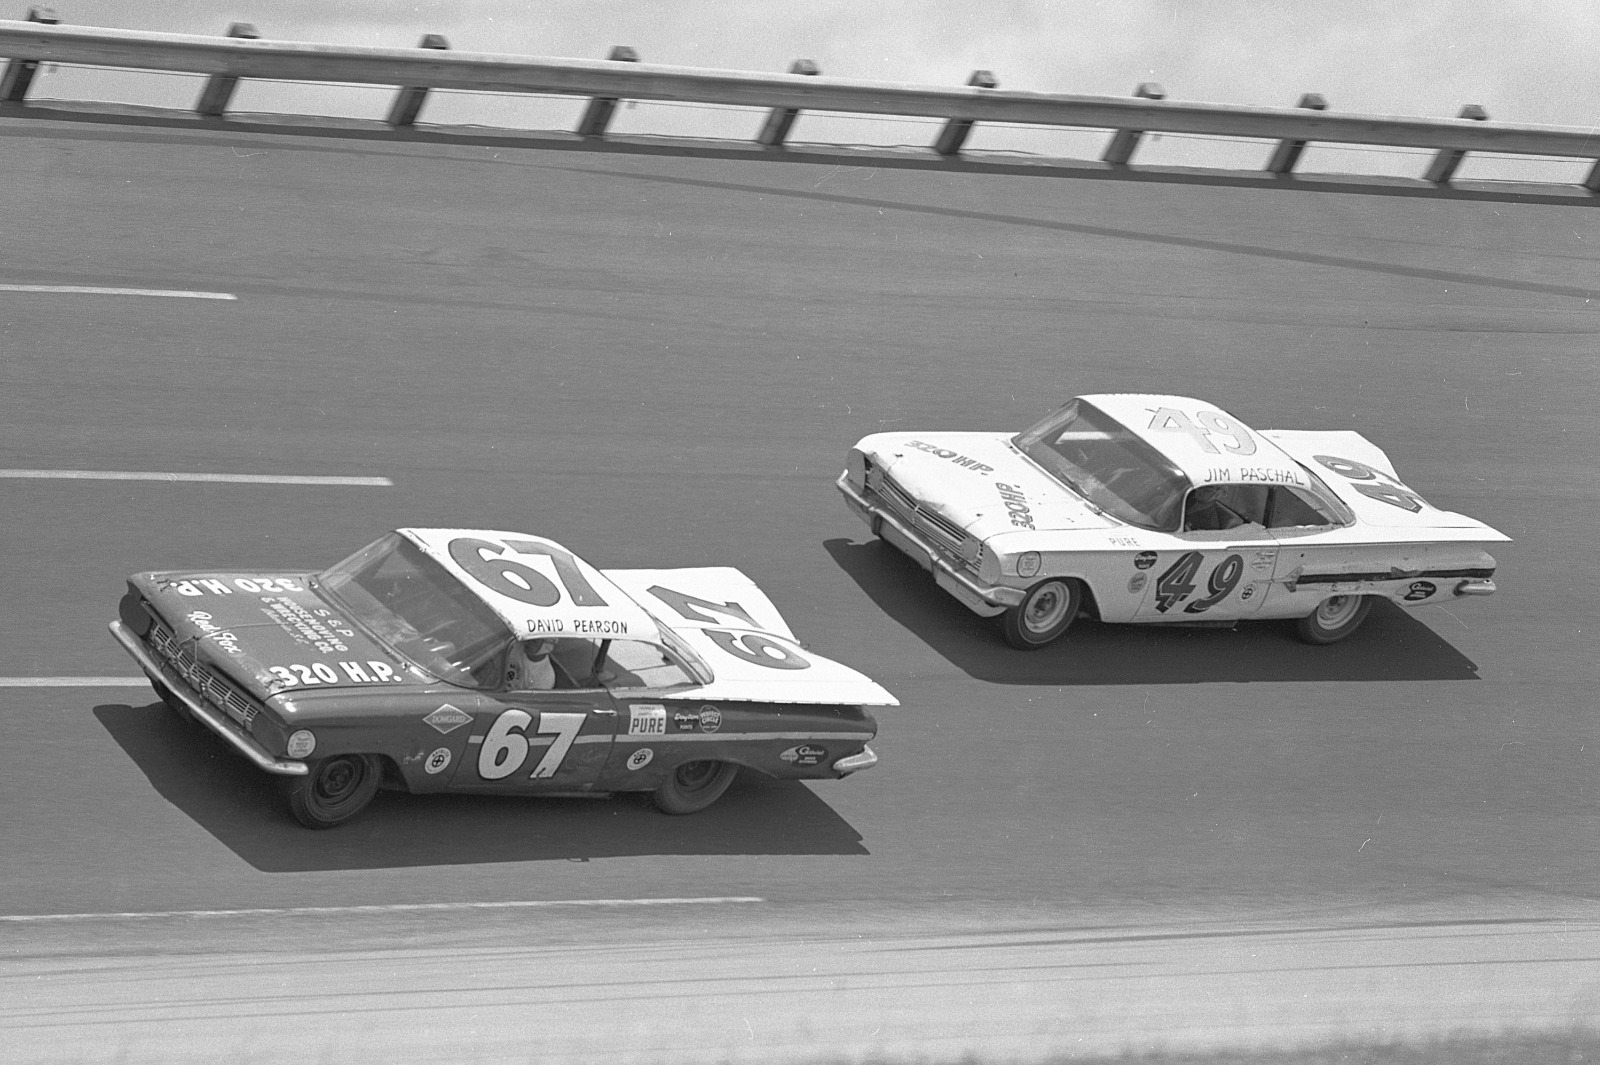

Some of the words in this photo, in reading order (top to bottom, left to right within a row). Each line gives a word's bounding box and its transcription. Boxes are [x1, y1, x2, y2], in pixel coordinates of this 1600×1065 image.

[1146, 406, 1257, 456] 49
[1204, 468, 1230, 482] JIM
[1241, 468, 1305, 485] PASCHAL
[1312, 455, 1428, 514] 49
[1108, 537, 1141, 547] PURE
[234, 578, 303, 593] 320
[448, 537, 609, 607] 67
[1155, 551, 1244, 614] 49
[527, 619, 564, 632] DAVID
[574, 620, 628, 634] PEARSON
[646, 585, 811, 670] 67
[269, 662, 339, 686] 320
[338, 660, 402, 682] H.P.
[631, 717, 664, 733] PURE
[478, 709, 587, 780] 67
